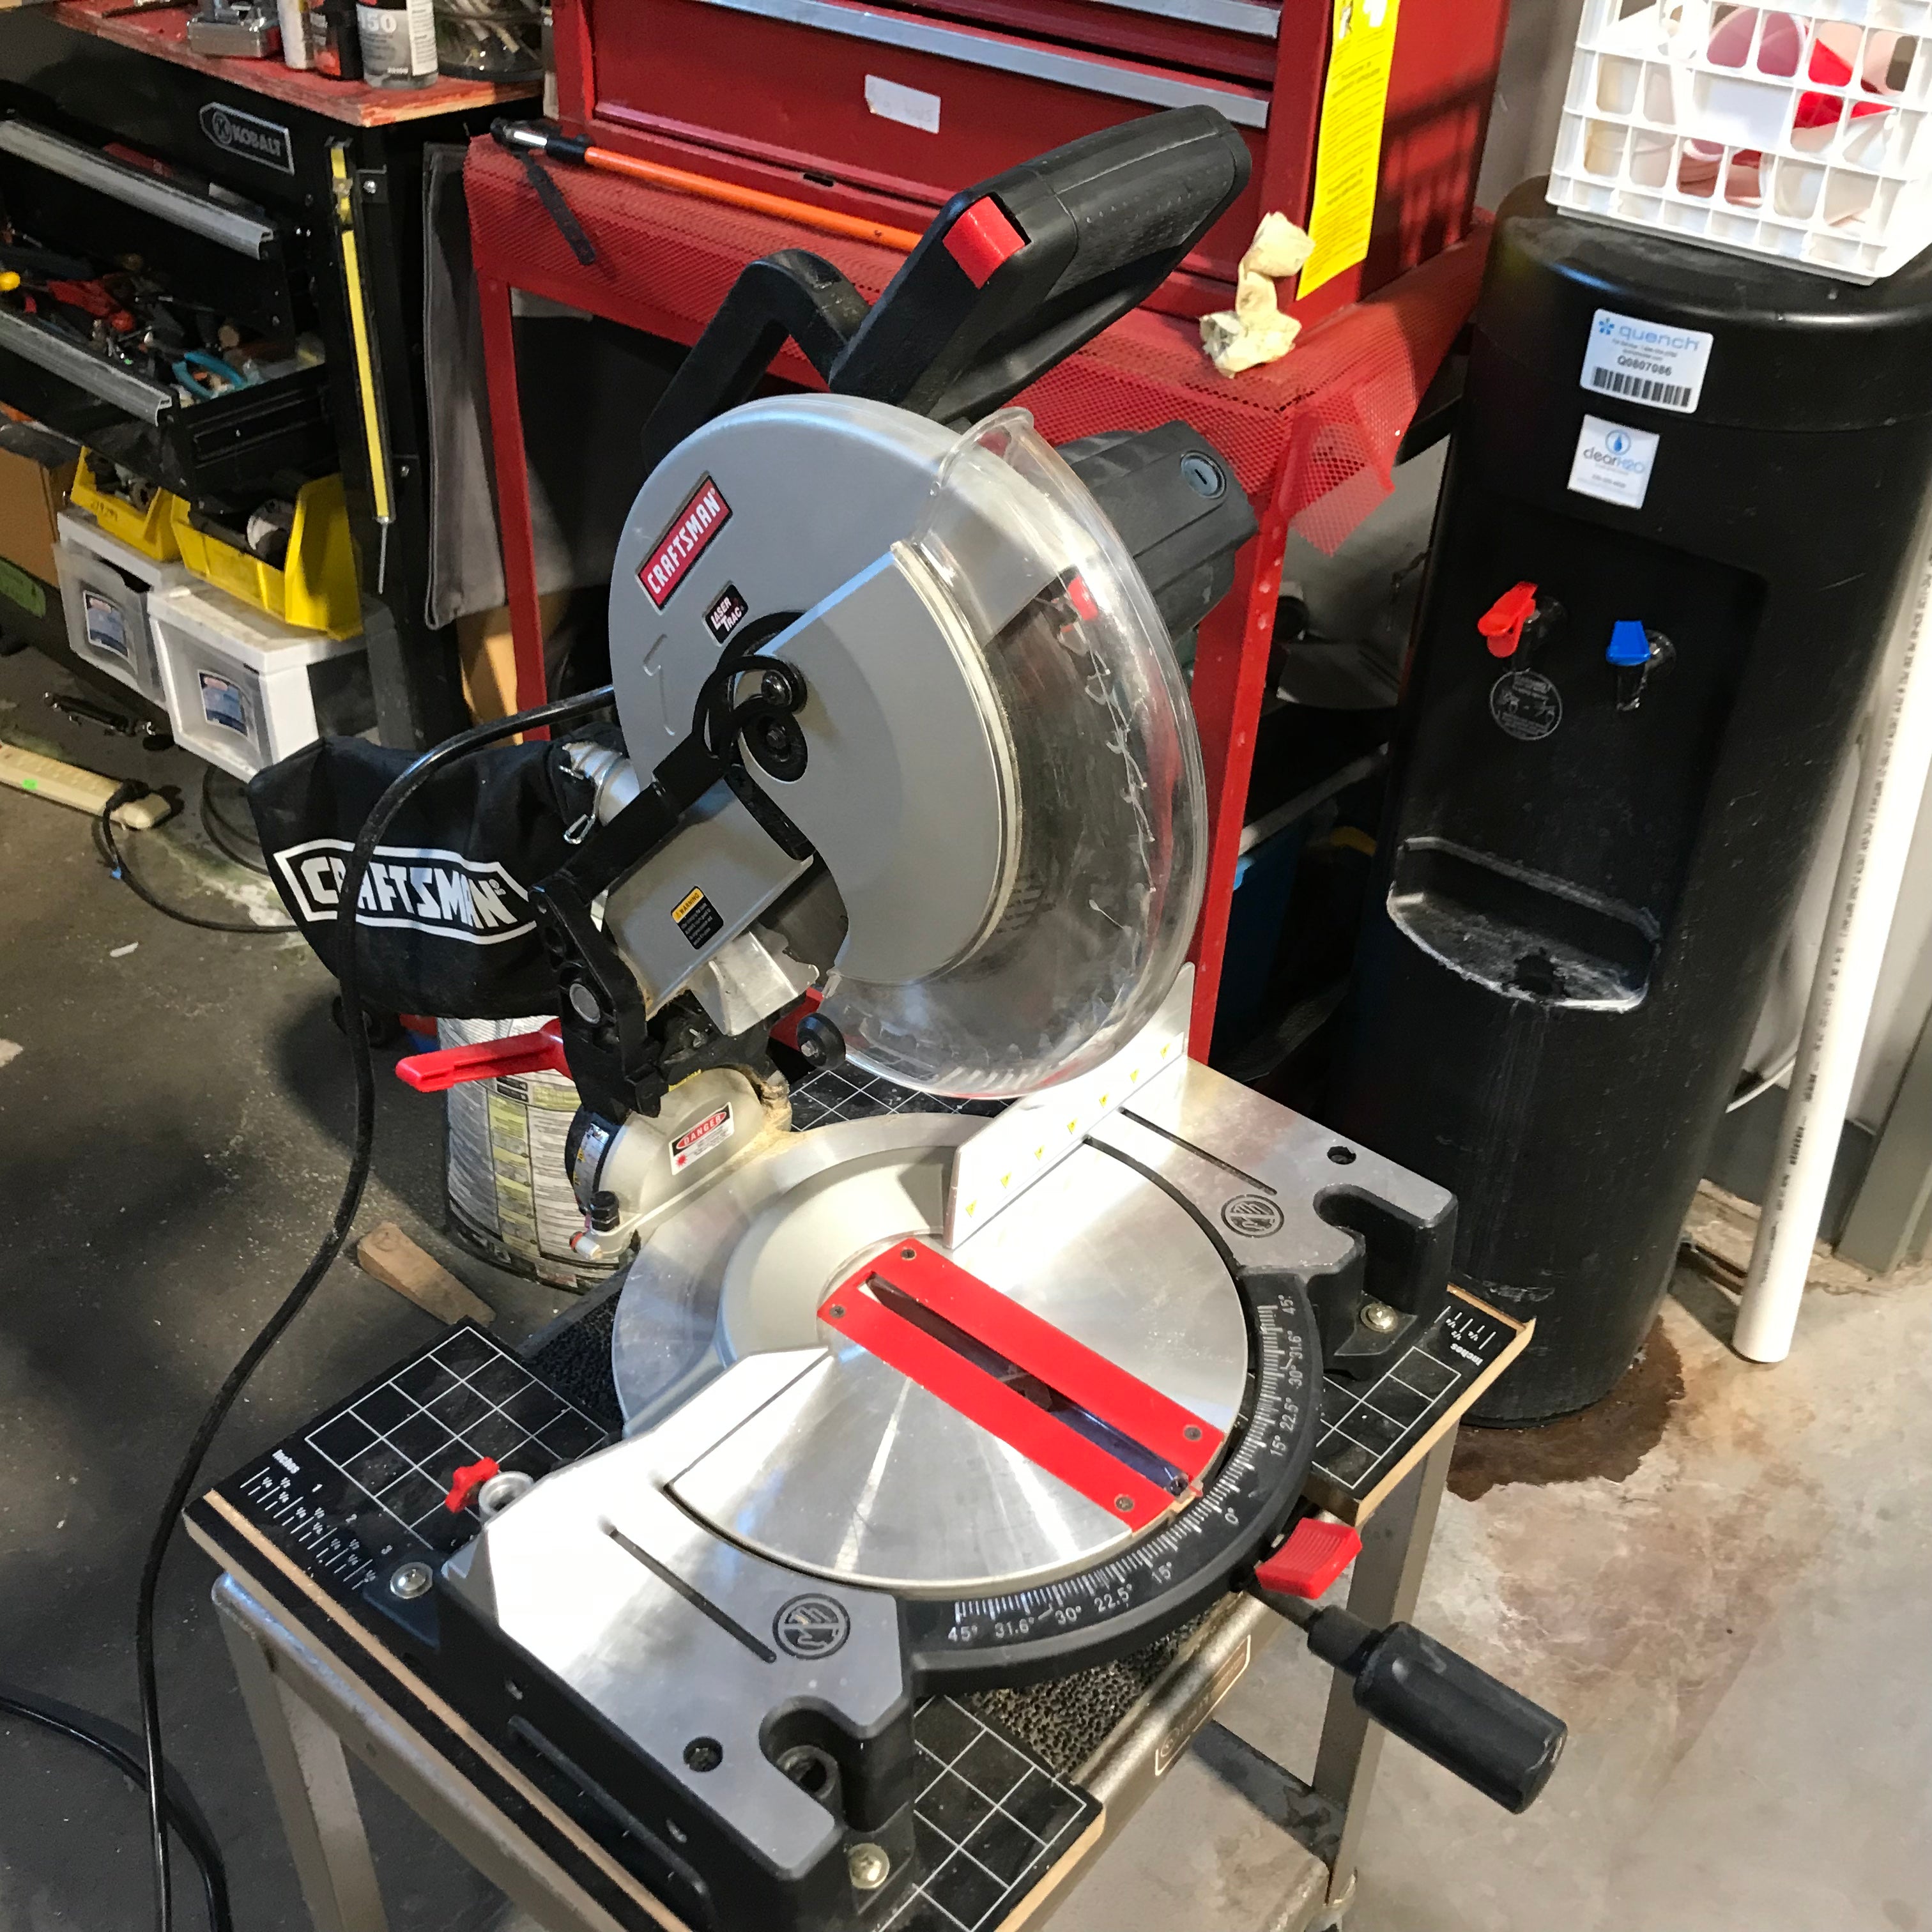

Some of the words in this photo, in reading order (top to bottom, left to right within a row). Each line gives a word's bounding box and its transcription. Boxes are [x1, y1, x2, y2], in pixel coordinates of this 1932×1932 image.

[1619, 325, 1699, 351] quench
[647, 490, 721, 594] CRAFTSMAN
[710, 597, 732, 630] LASER
[679, 892, 700, 915] WARNING
[684, 1115, 721, 1146] DANGER
